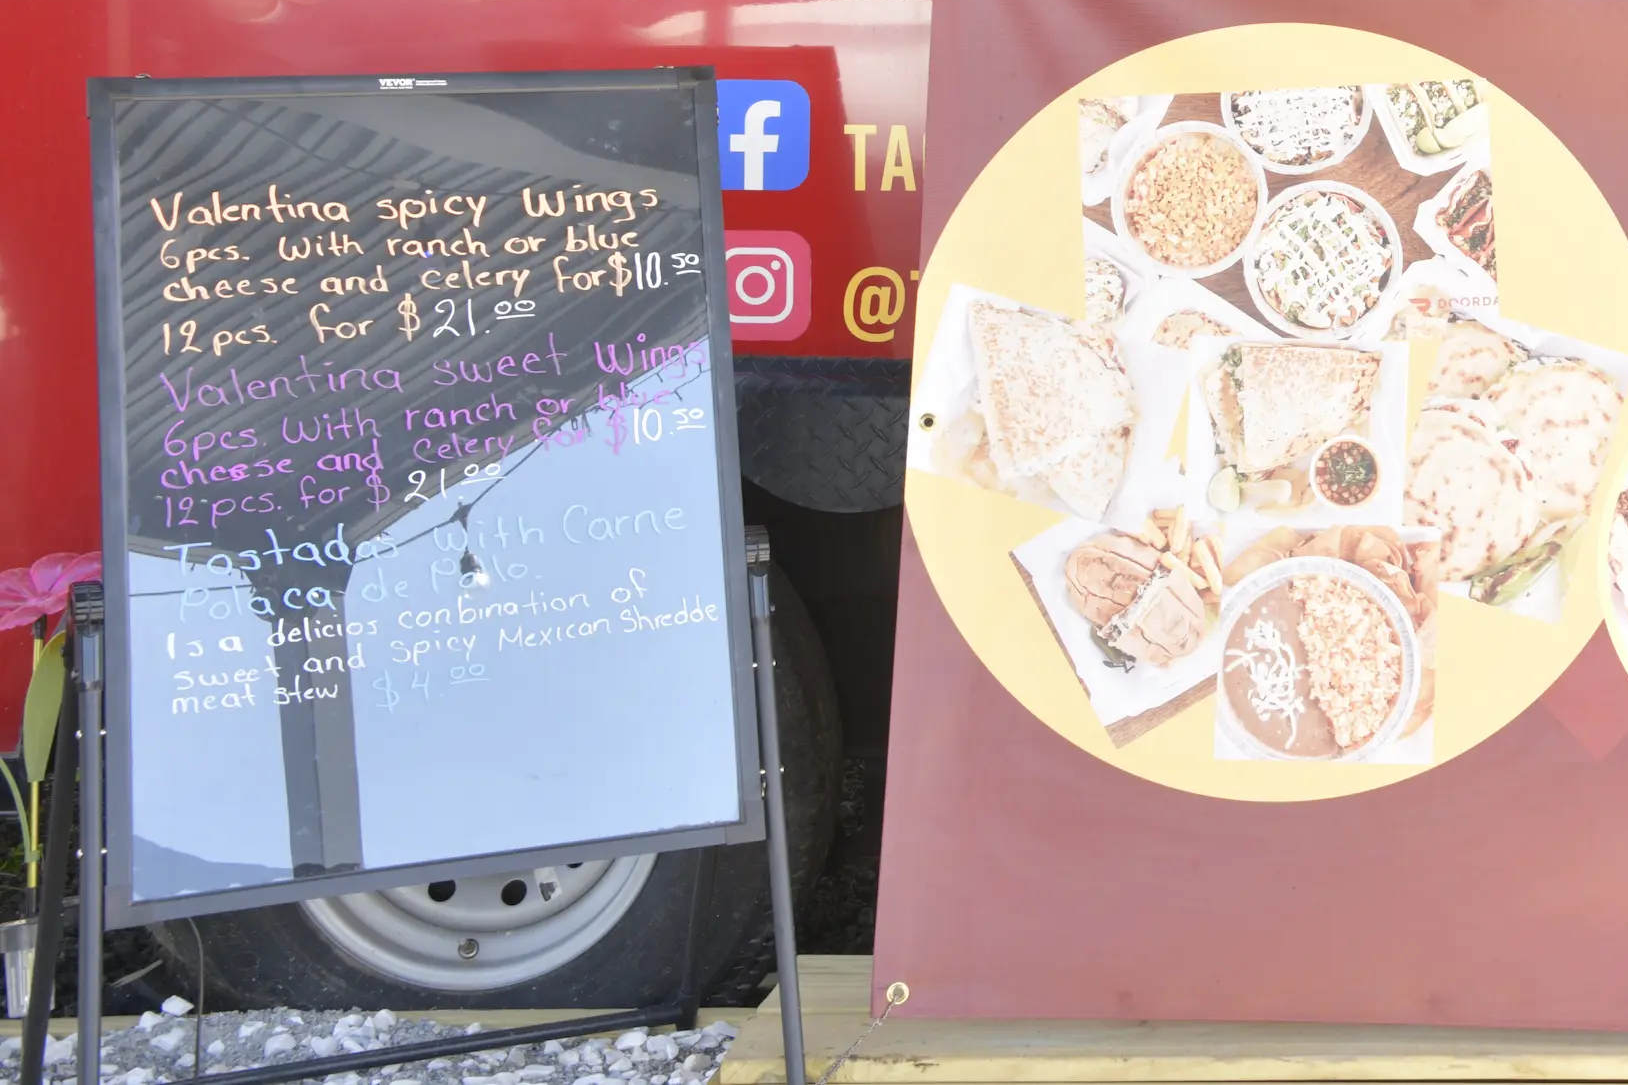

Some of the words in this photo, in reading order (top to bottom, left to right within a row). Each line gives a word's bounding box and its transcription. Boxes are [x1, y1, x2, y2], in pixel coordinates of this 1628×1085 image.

[379, 78, 413, 87] VEVOR
[843, 124, 926, 192] TA
[151, 184, 350, 231] Valentina
[377, 193, 487, 230] spicy
[523, 185, 658, 222] Wings
[386, 231, 486, 258] ranch
[504, 232, 546, 254] or
[566, 227, 639, 251] blue
[164, 272, 299, 302] cheese
[320, 265, 387, 293] and
[420, 262, 530, 294] celery
[310, 303, 374, 345] for
[161, 354, 401, 414] Valentina
[432, 332, 566, 387] sweet
[595, 333, 708, 377] Wings
[404, 400, 513, 430] ranch
[536, 395, 574, 416] or
[598, 384, 673, 411] blue
[161, 455, 294, 490] cheese
[317, 439, 383, 473] and
[533, 417, 587, 448] for
[300, 476, 351, 509] for
[164, 522, 398, 578] Tostadas
[563, 504, 688, 544] Carne
[361, 571, 407, 602] de
[219, 635, 245, 656] a
[266, 618, 378, 649] delicios
[611, 566, 649, 602] of
[174, 656, 281, 690] sweet
[304, 643, 366, 674] and
[499, 618, 611, 651] Mexican
[171, 680, 257, 714] meat
[273, 681, 338, 705] stew
